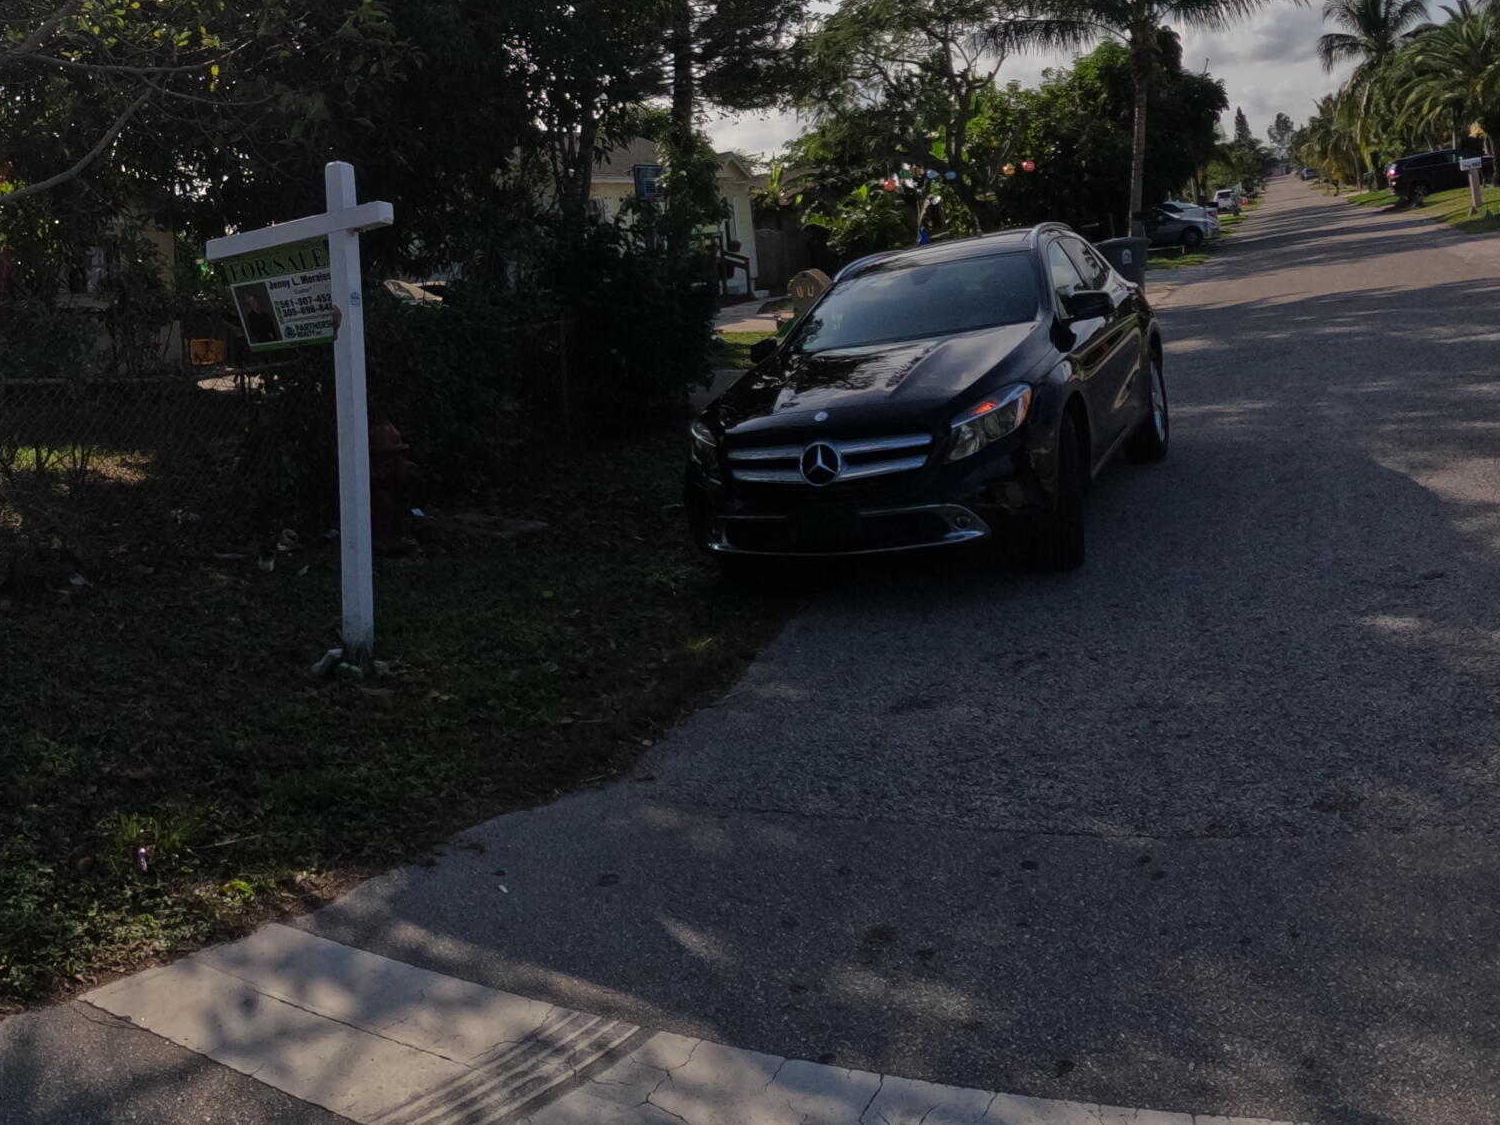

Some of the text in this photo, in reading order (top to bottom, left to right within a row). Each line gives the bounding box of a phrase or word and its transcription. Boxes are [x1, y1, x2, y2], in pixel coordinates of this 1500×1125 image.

[228, 248, 327, 282] FOR SALE
[268, 279, 290, 290] Jenny
[300, 272, 331, 284] Morales
